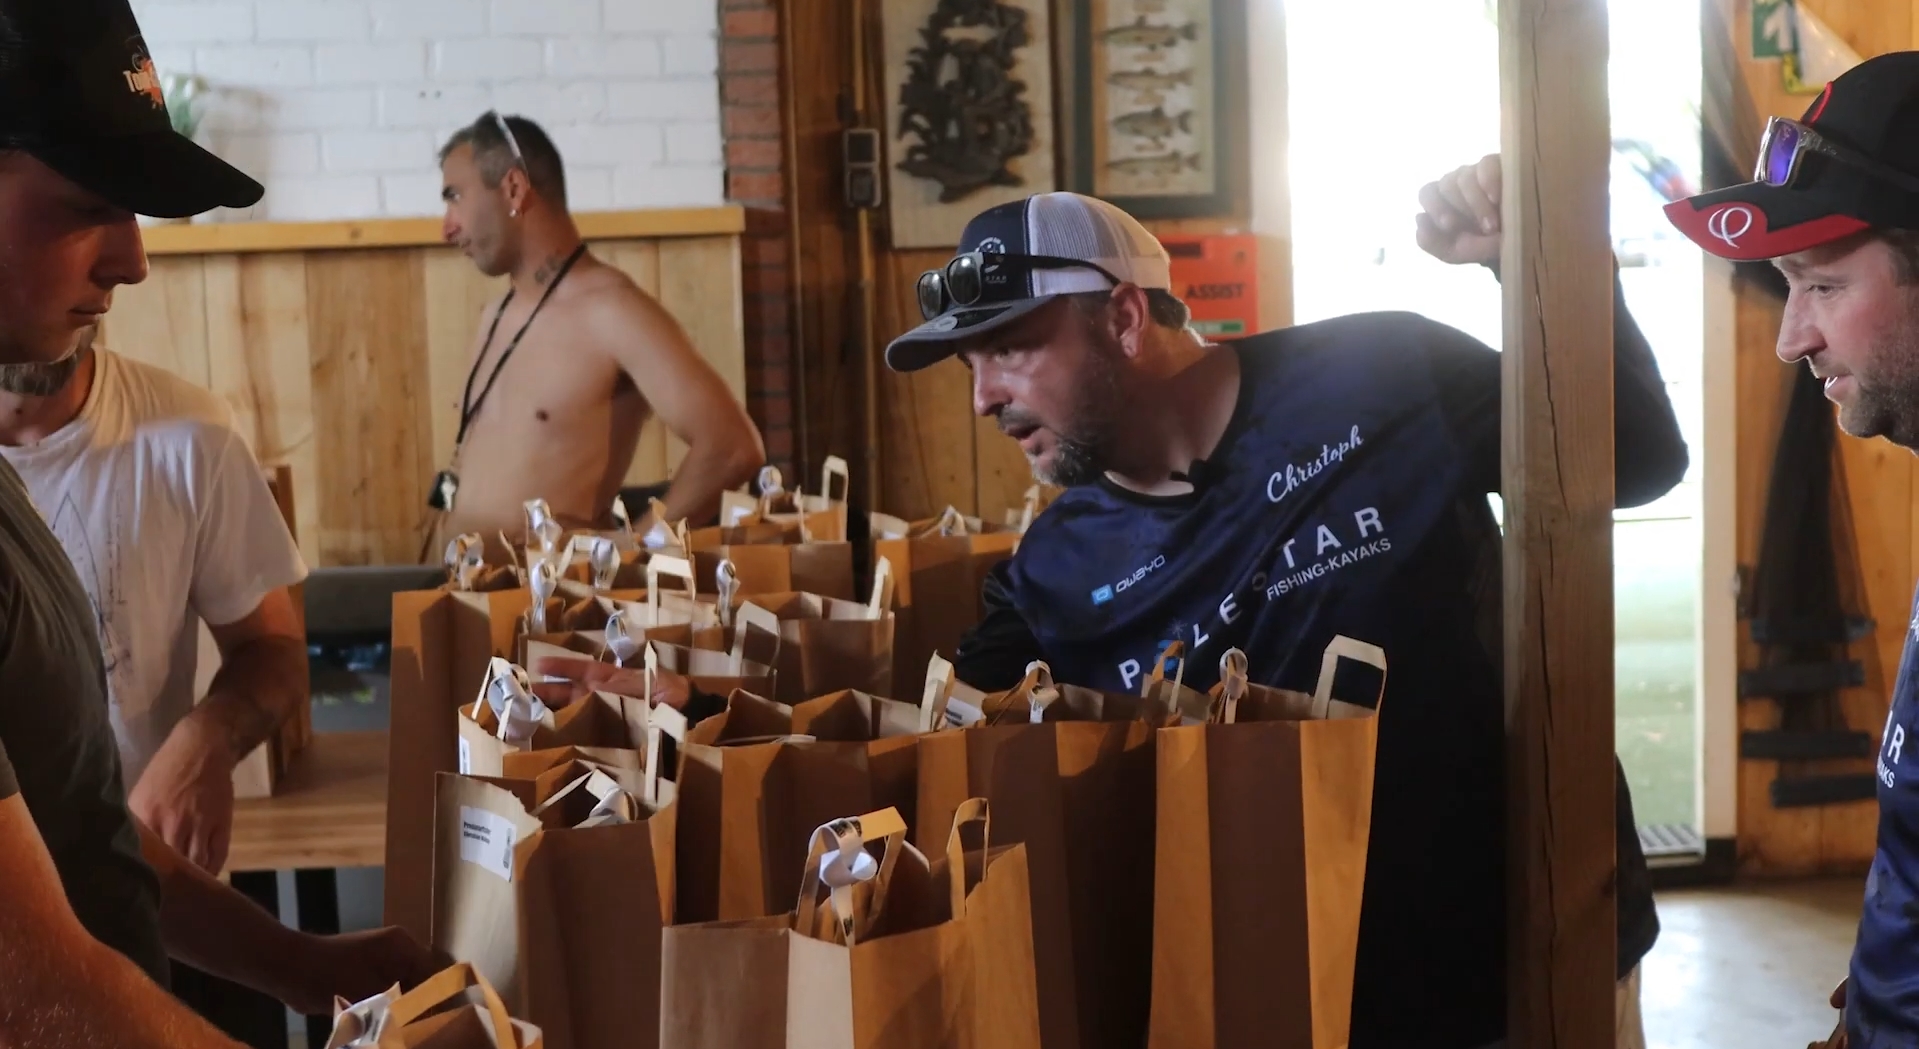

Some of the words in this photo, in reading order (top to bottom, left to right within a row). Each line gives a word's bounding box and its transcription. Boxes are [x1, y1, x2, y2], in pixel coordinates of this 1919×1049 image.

[1185, 283, 1244, 299] ASSIST
[1266, 424, 1364, 503] Christoph
[1266, 537, 1392, 601] FISHING-KAYAKS
